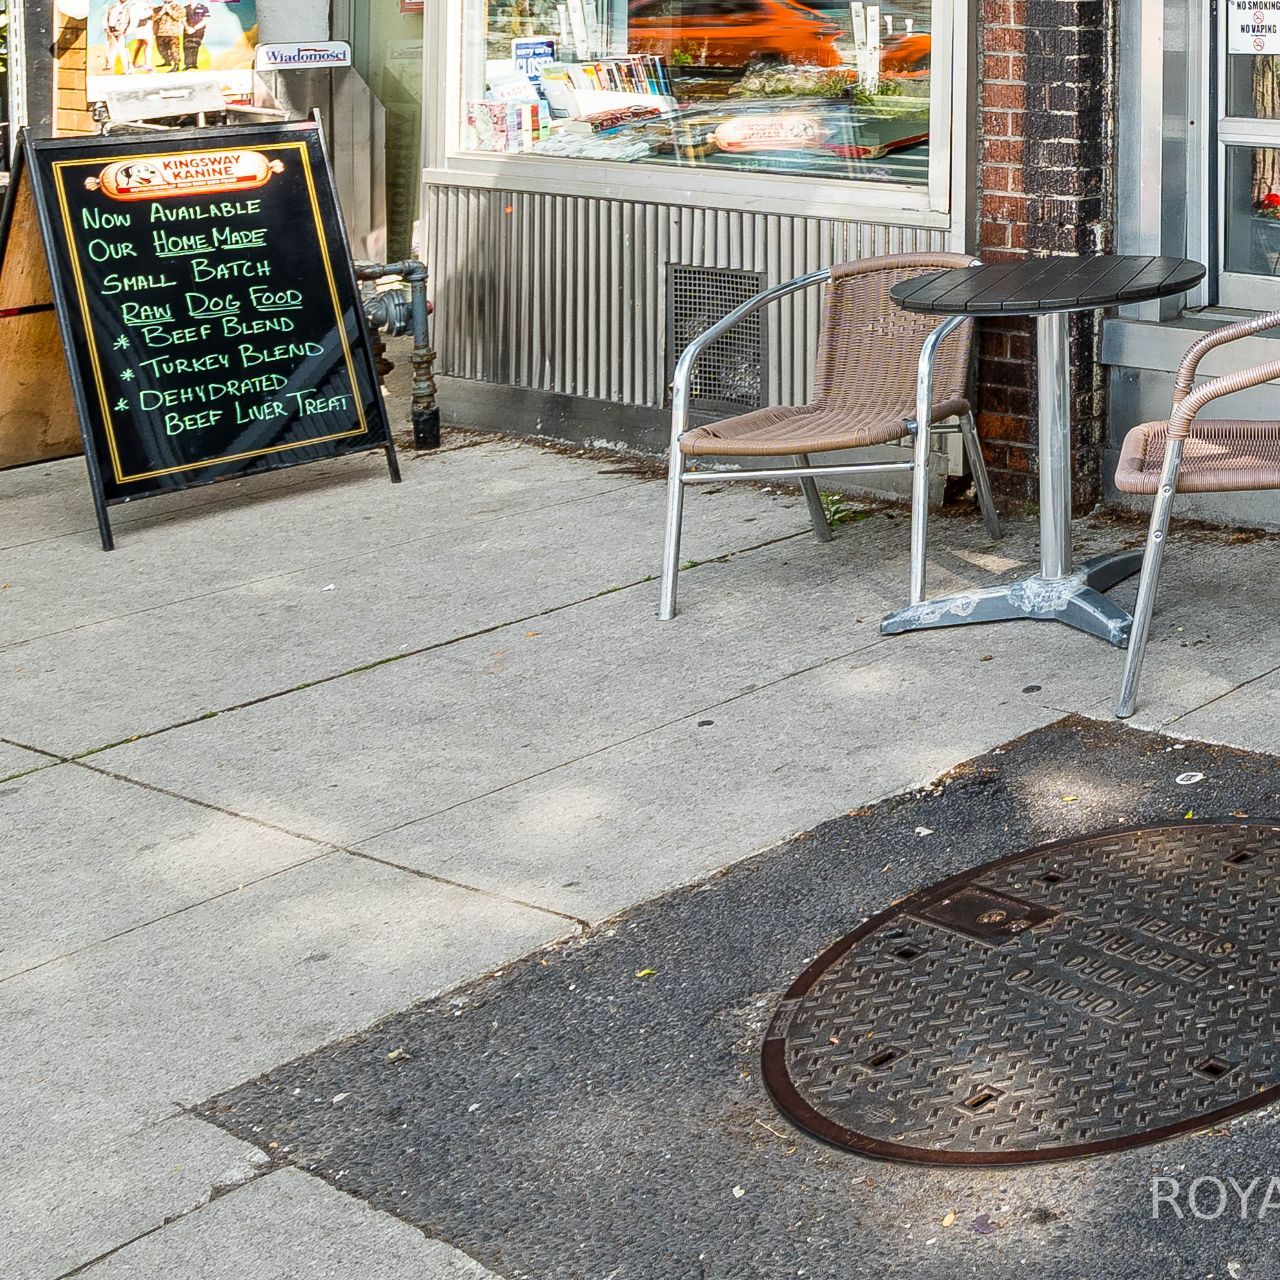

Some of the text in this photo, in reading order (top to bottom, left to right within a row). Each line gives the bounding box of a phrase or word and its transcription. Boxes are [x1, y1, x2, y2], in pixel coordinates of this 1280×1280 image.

[1237, 1, 1280, 10] NO SMOKING
[1241, 25, 1277, 33] NO VAPING
[266, 48, 347, 62] Wiadomości
[162, 155, 241, 170] KINGSWAY
[173, 166, 234, 181] KANINE
[1062, 954, 1163, 998] HYDRO
[1004, 967, 1135, 1024] TORONTO
